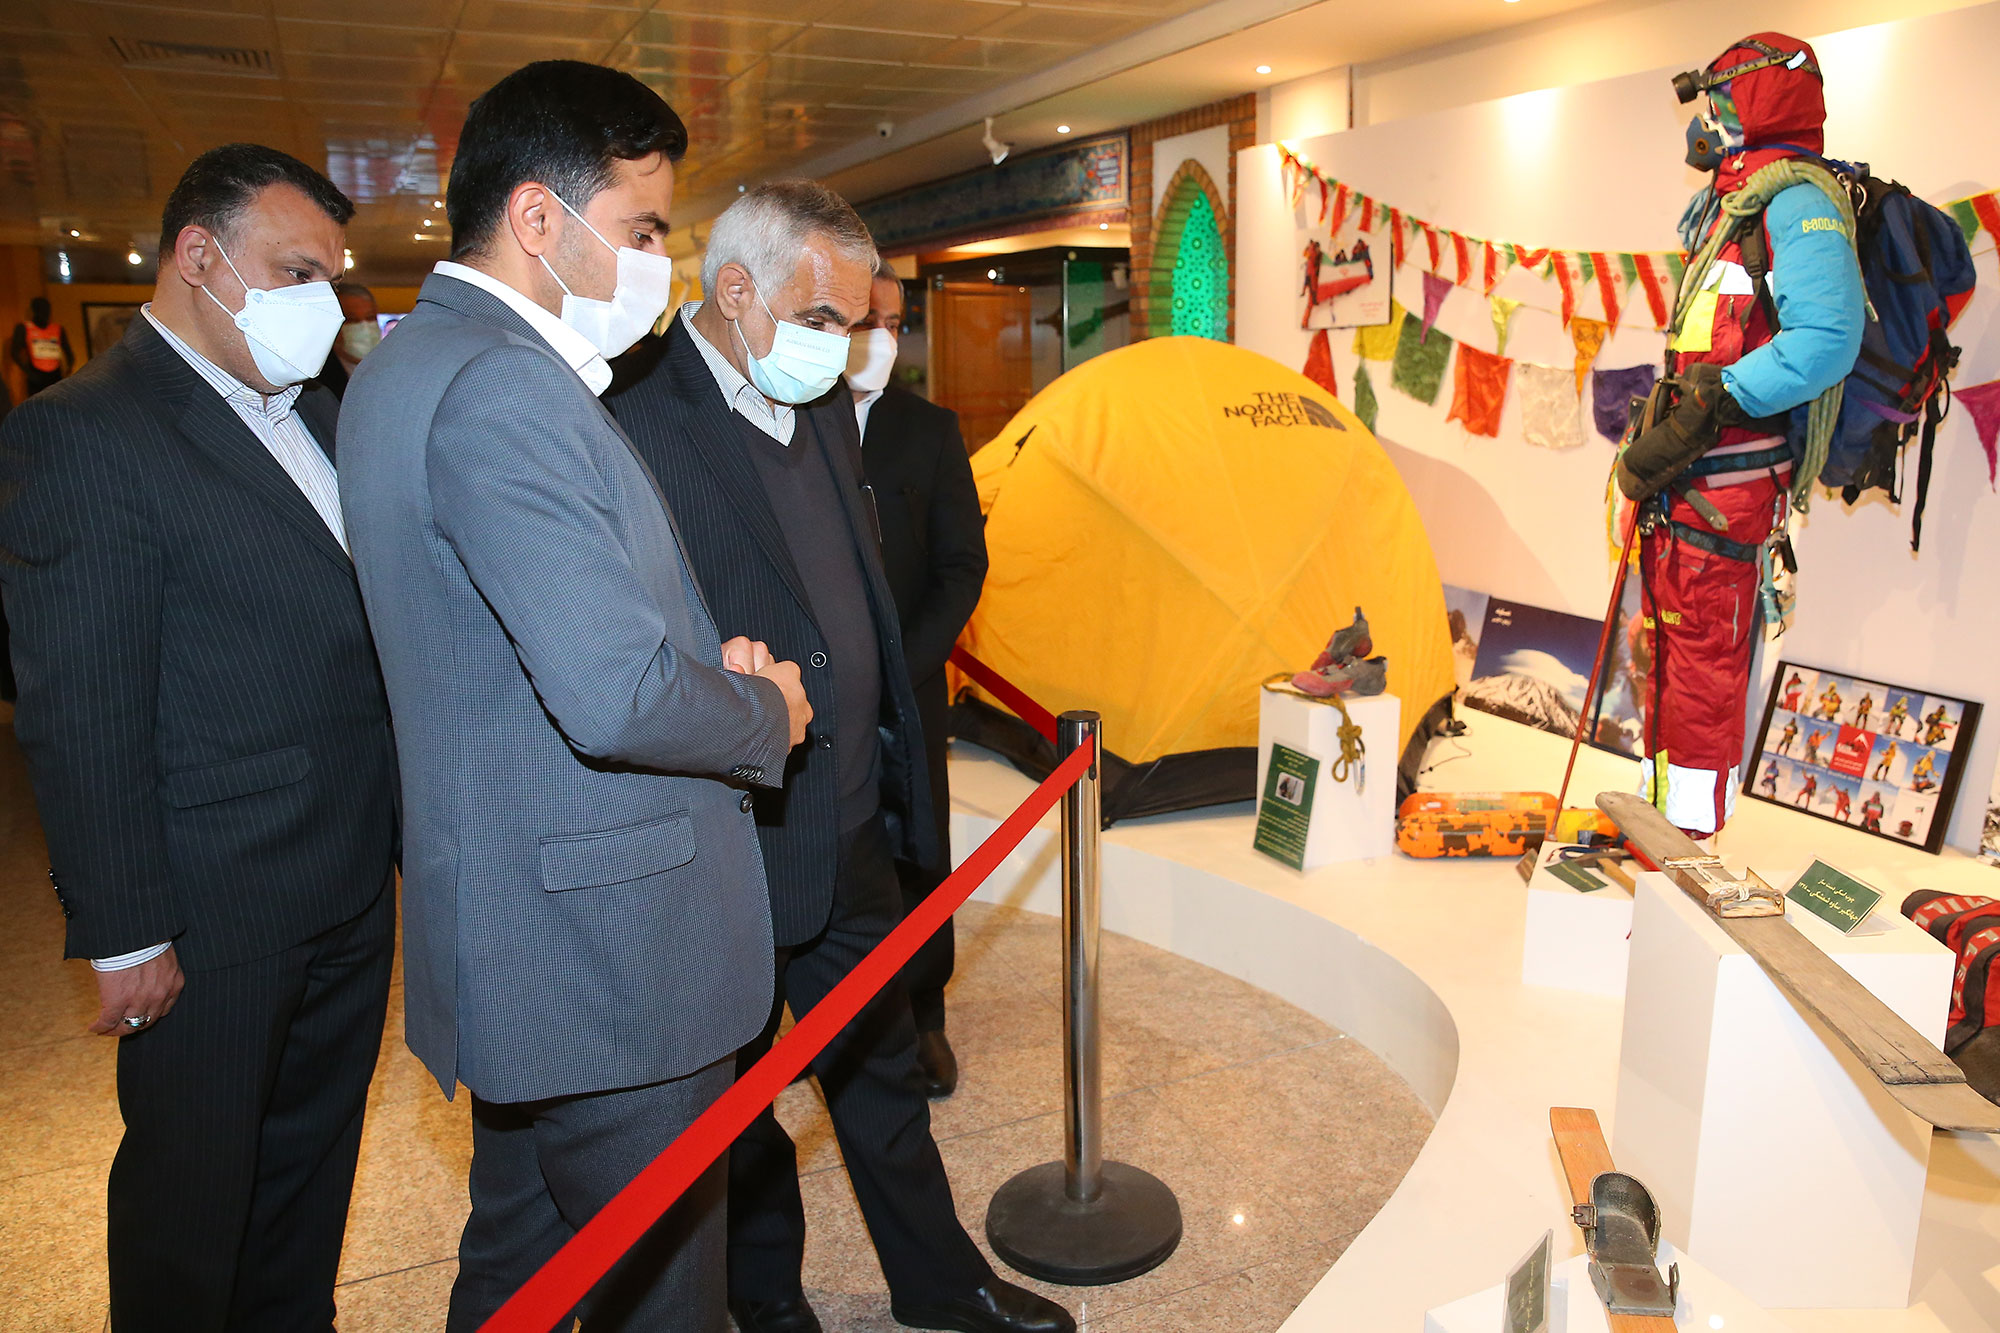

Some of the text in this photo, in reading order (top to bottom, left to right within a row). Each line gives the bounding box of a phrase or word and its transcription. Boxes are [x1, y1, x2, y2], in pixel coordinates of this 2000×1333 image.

[1252, 392, 1295, 405] THE
[1223, 404, 1305, 418] NORTH
[1251, 415, 1309, 428] FACE
